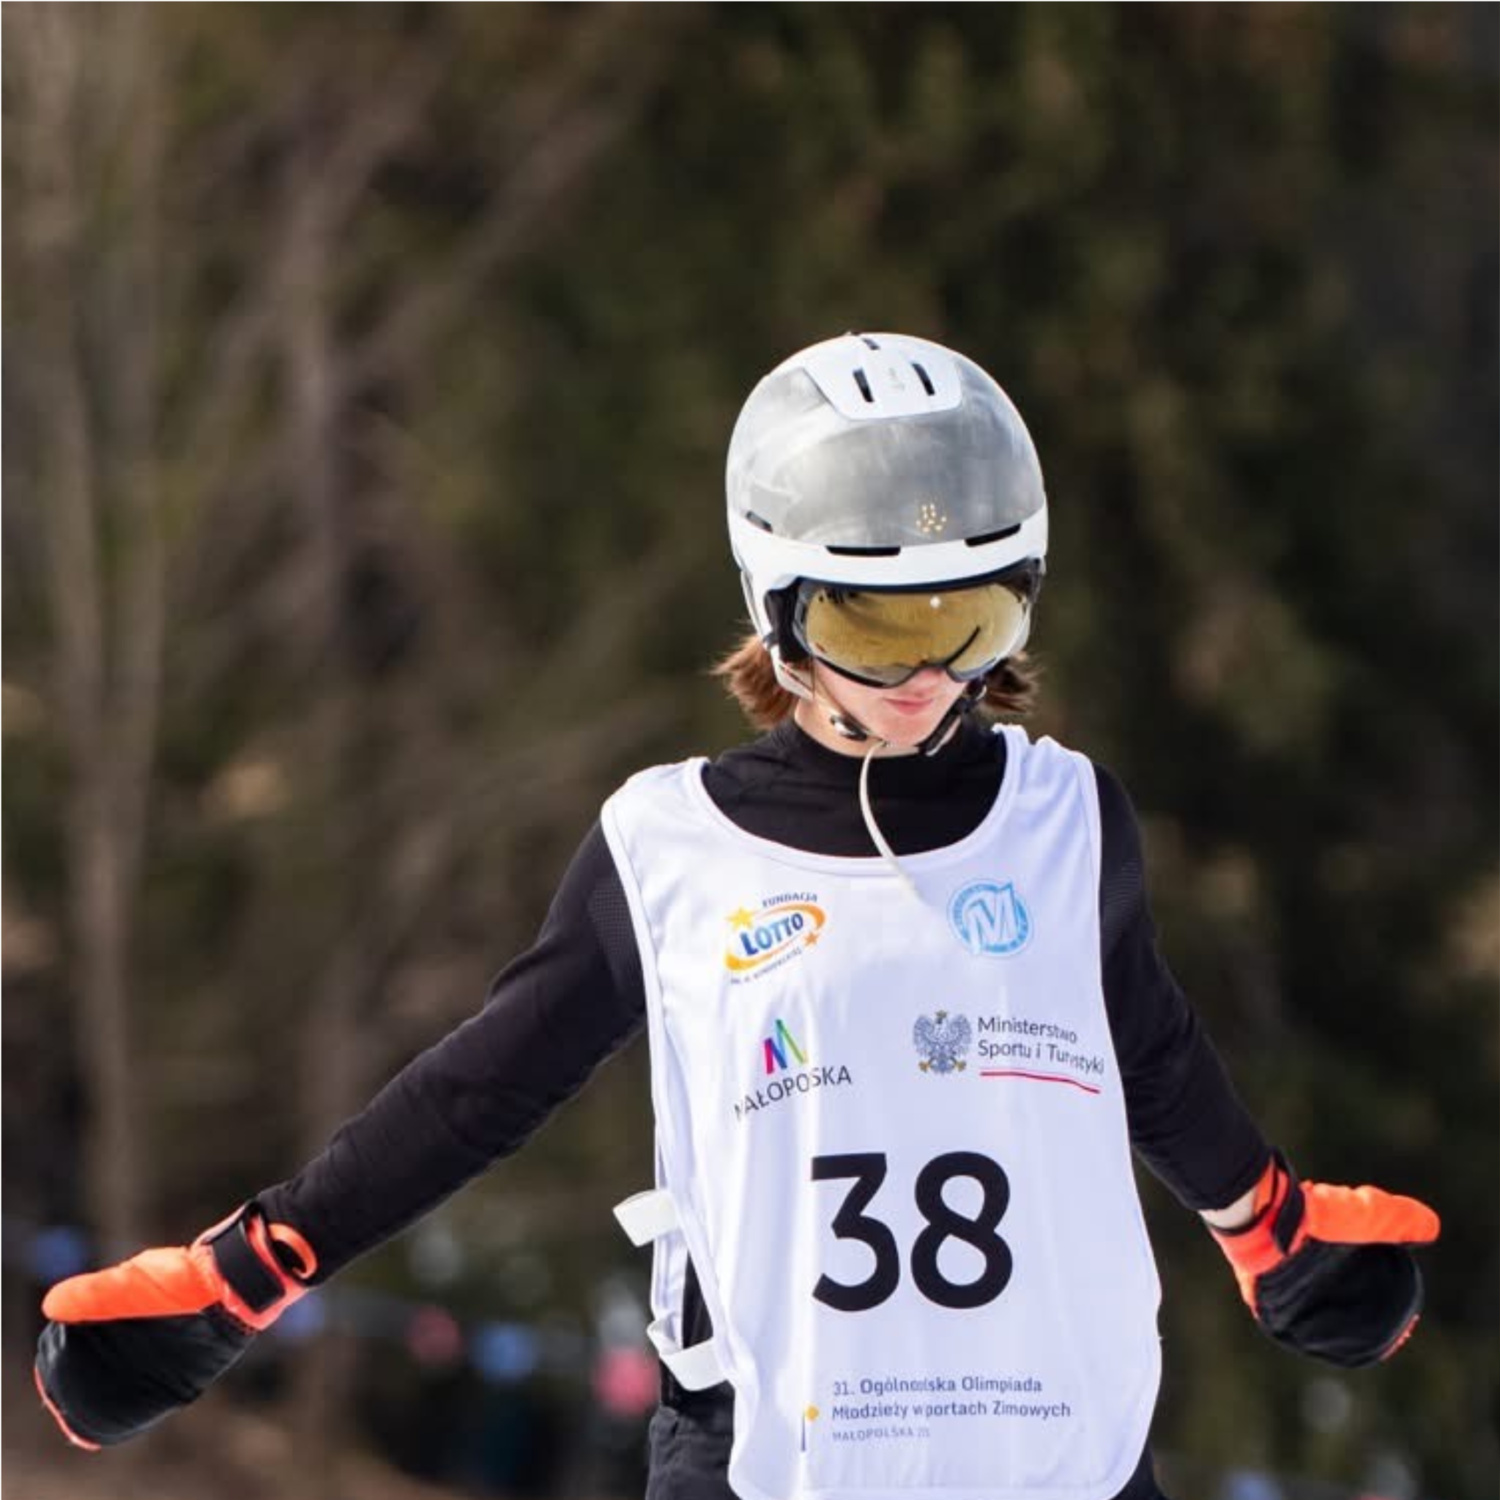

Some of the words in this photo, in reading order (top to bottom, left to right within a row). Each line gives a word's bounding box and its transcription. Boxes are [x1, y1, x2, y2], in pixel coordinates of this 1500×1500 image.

[739, 912, 804, 957] LOTTO
[977, 1016, 1078, 1044] Ministerstwo
[977, 1039, 1031, 1059] Sportu
[1035, 1043, 1041, 1059] i
[810, 1150, 1014, 1313] 38
[833, 1380, 856, 1396] 31.
[961, 1375, 1043, 1394] Olimpiada
[832, 1402, 908, 1420] Młodzieży
[925, 1400, 988, 1418] portach
[992, 1400, 1071, 1421] Zimowych
